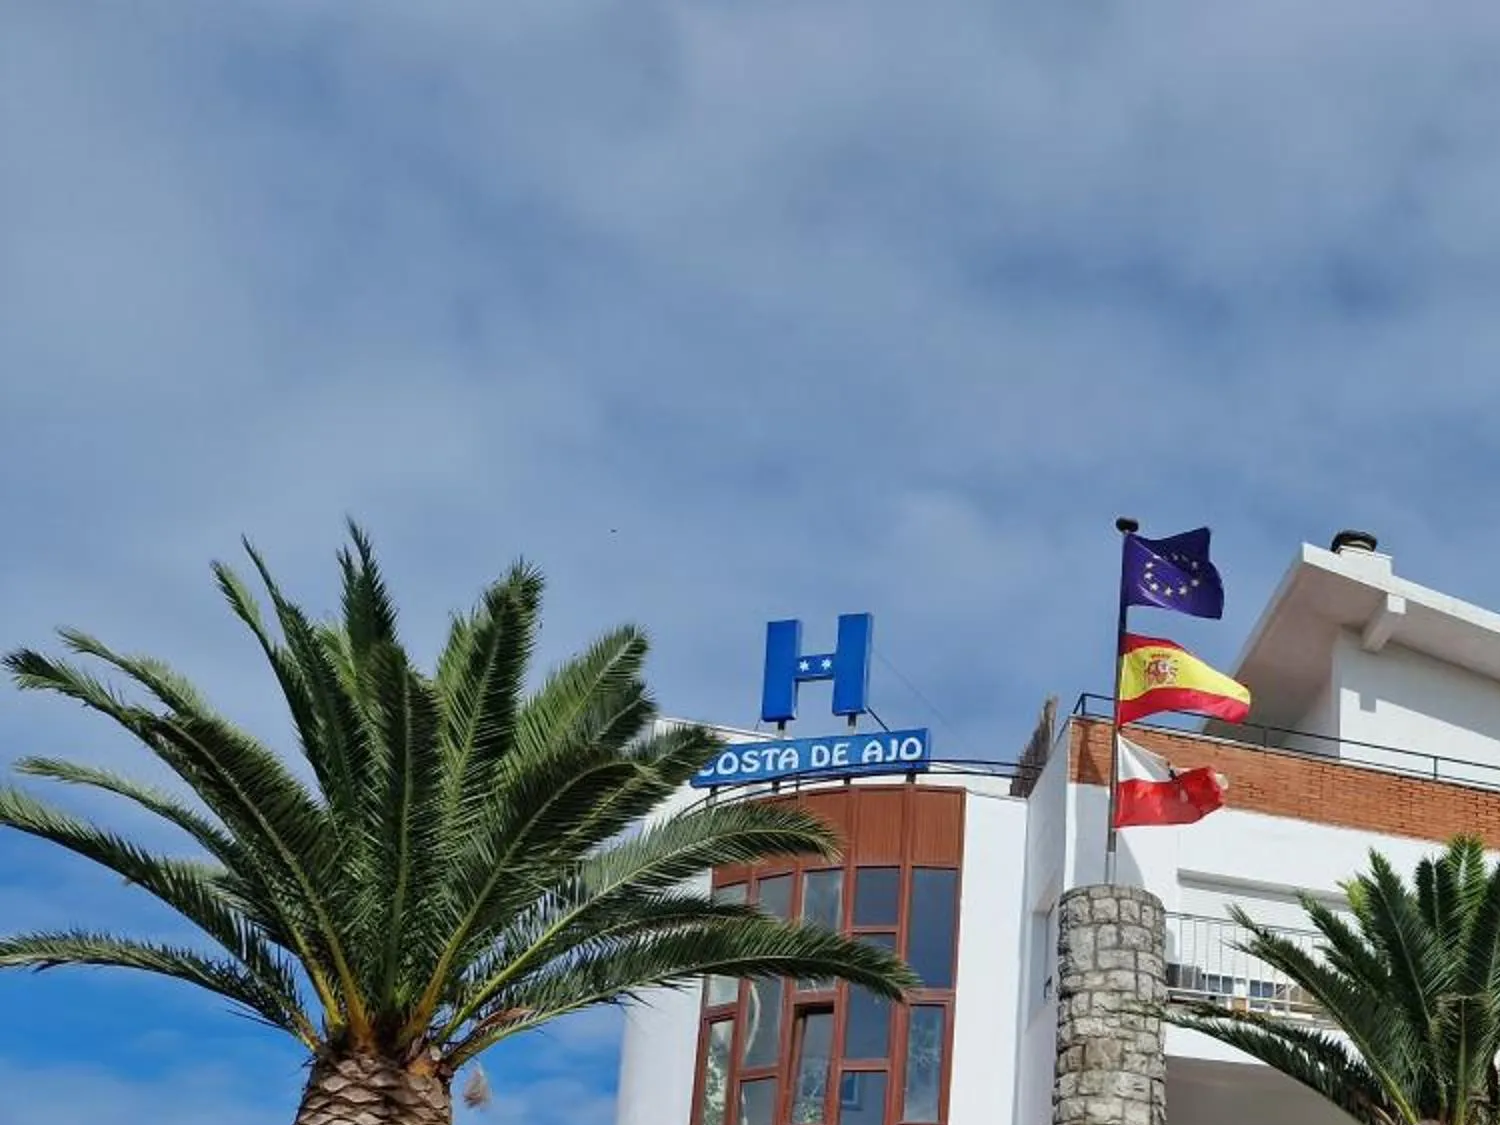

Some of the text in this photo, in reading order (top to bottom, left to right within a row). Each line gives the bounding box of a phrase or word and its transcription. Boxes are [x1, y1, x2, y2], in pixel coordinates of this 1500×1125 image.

[762, 613, 873, 722] H
[811, 743, 849, 766] DE
[862, 737, 923, 763] AJO
